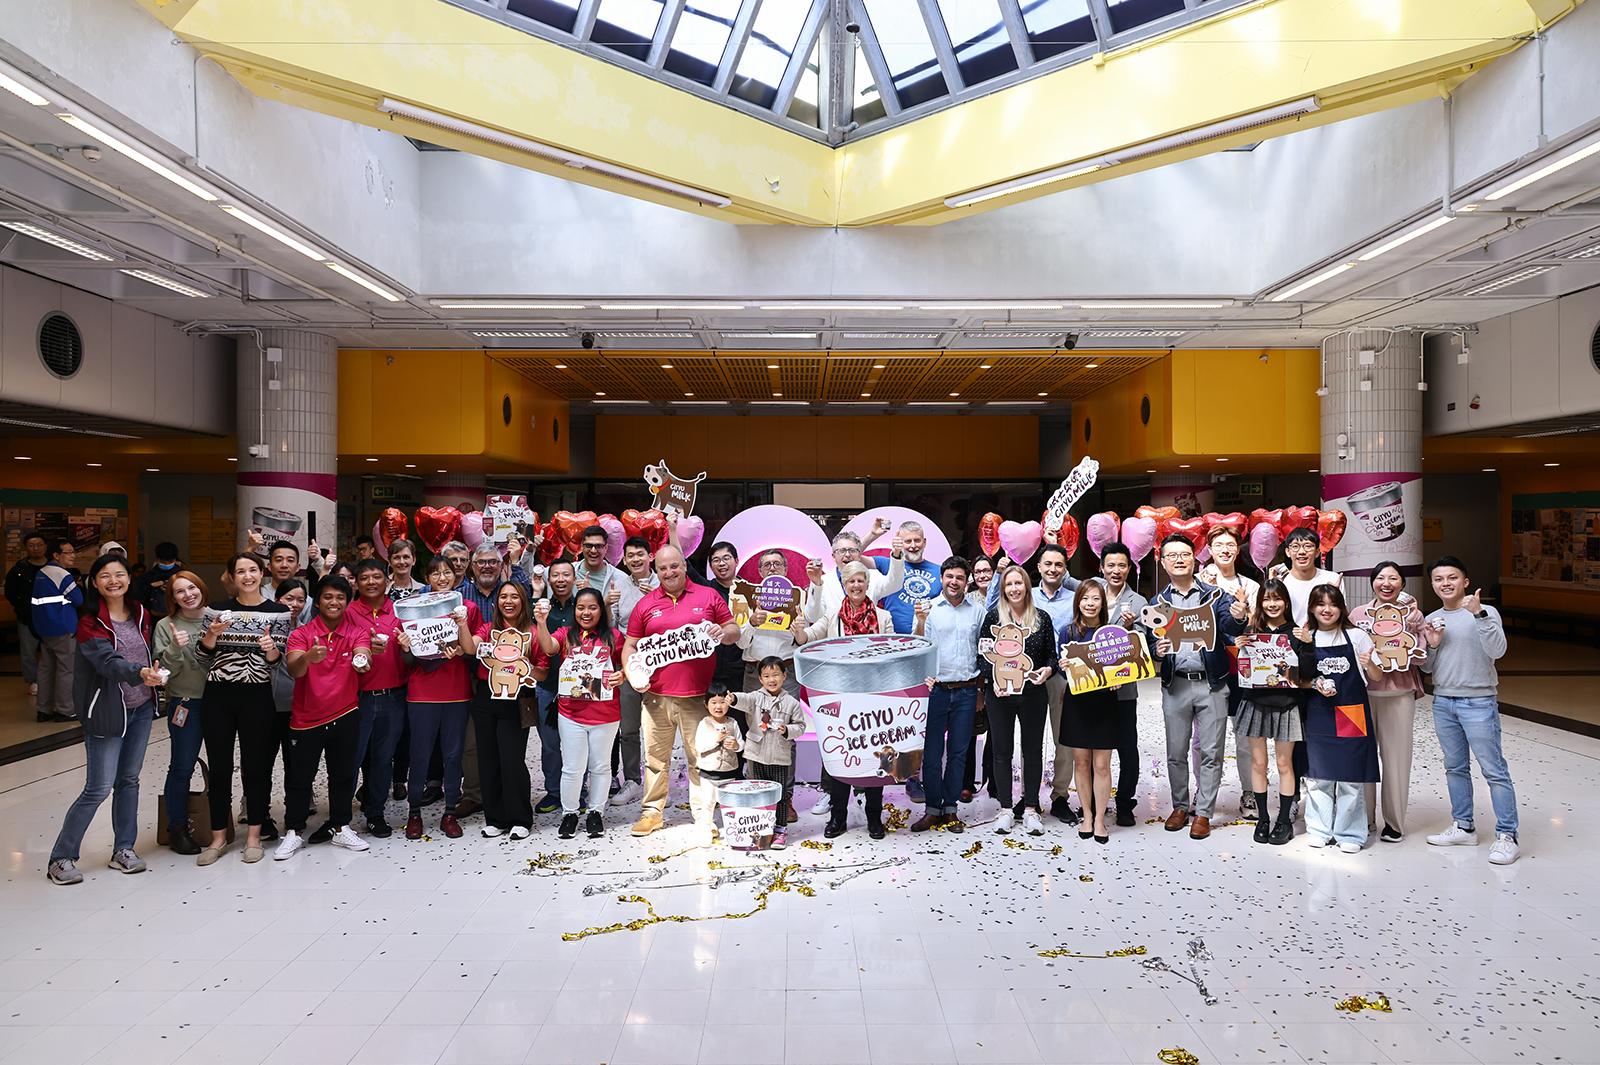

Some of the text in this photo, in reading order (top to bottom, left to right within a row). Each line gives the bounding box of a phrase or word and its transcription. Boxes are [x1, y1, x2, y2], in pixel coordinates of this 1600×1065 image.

[1087, 644, 1135, 659] Fresh milk from
[1094, 651, 1131, 664] CityU Farm
[870, 725, 916, 747] CREAM
